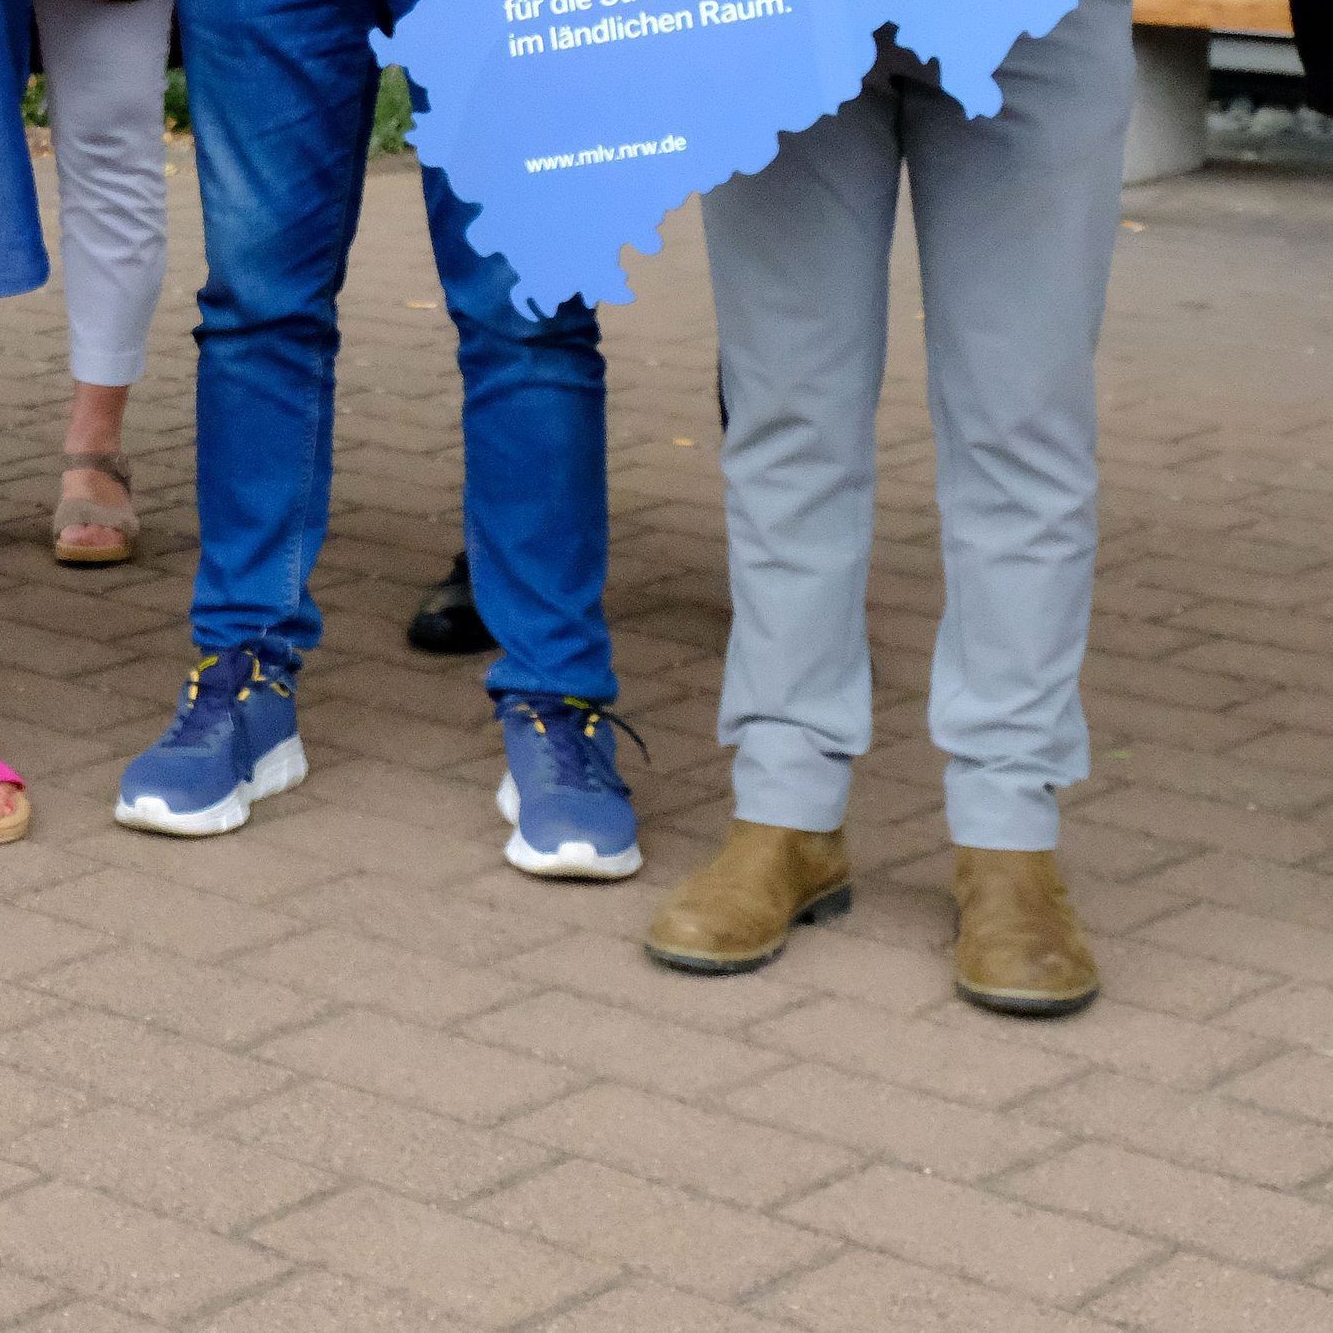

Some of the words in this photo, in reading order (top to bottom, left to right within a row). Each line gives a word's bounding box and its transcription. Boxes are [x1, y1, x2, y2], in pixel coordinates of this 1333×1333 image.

[509, 34, 543, 57] im
[550, 10, 693, 50] ländlichen
[525, 135, 686, 172] www.mlv.nrw.de
